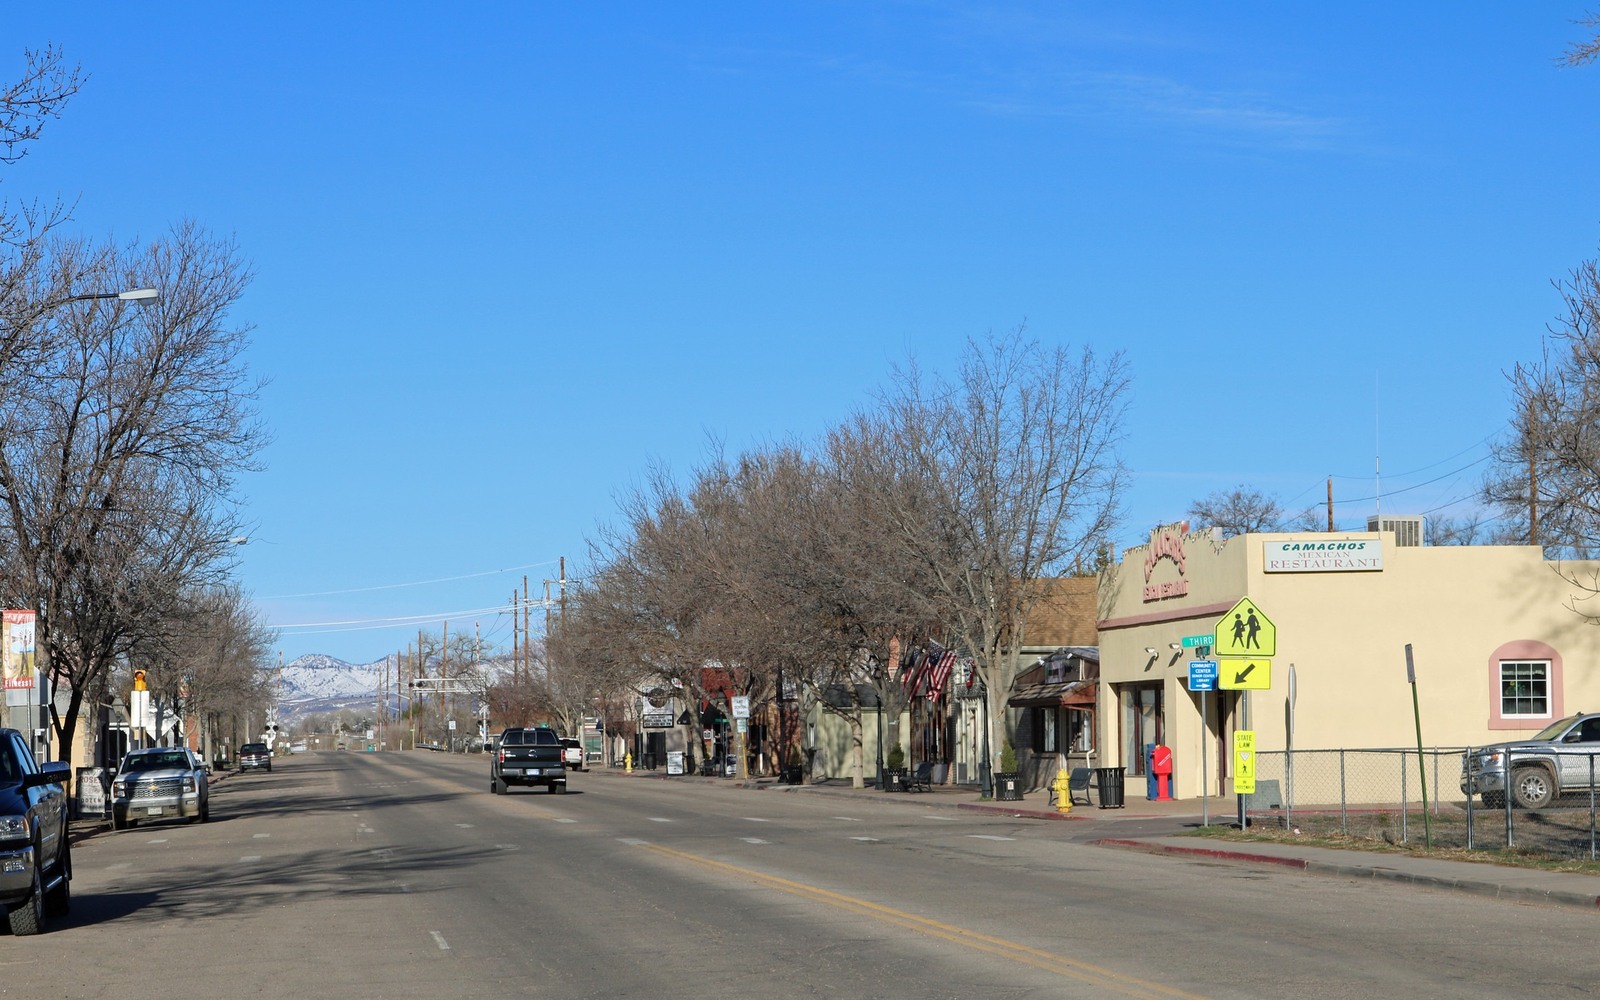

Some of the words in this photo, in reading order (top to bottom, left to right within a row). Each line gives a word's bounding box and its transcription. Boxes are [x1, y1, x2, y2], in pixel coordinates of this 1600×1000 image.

[1281, 542, 1366, 551] CAMACHOS
[1298, 551, 1350, 559] MEXICAN
[1270, 558, 1379, 569] RESTAURANT
[1189, 636, 1213, 646] THIRD
[1237, 734, 1252, 742] STATE
